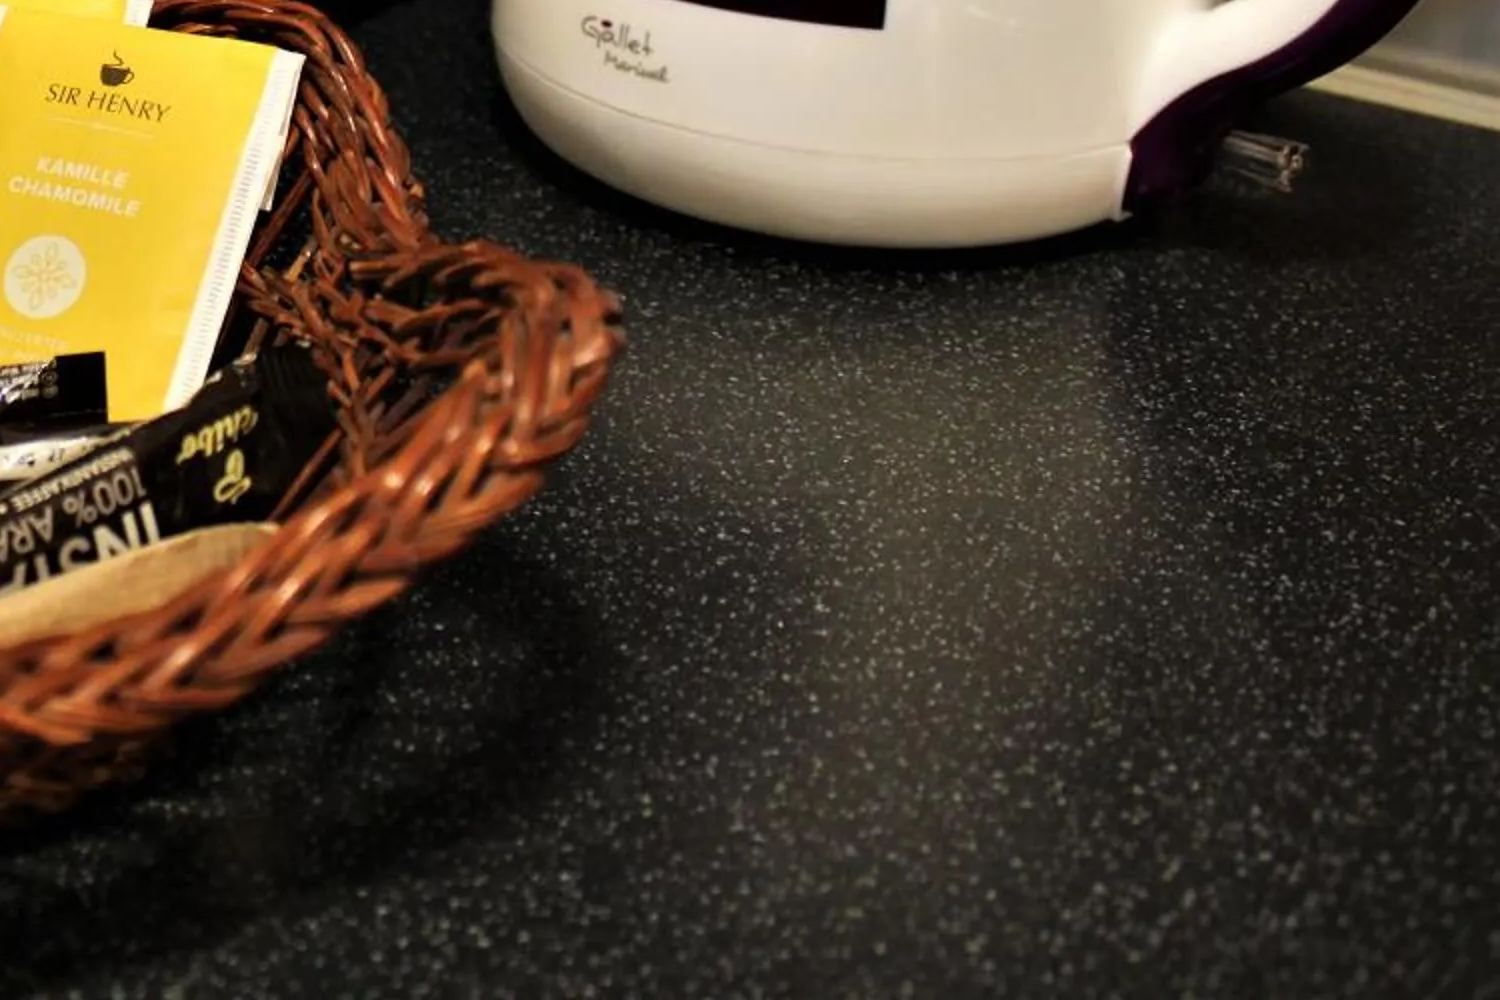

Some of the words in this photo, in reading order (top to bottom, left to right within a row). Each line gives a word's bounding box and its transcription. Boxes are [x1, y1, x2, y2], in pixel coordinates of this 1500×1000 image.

[580, 15, 655, 57] Gallet
[45, 82, 81, 106] SIR
[87, 90, 172, 123] HENRY
[36, 155, 130, 190] KAMILLE
[7, 175, 144, 219] CHAMOMILE
[61, 465, 148, 527] 100%
